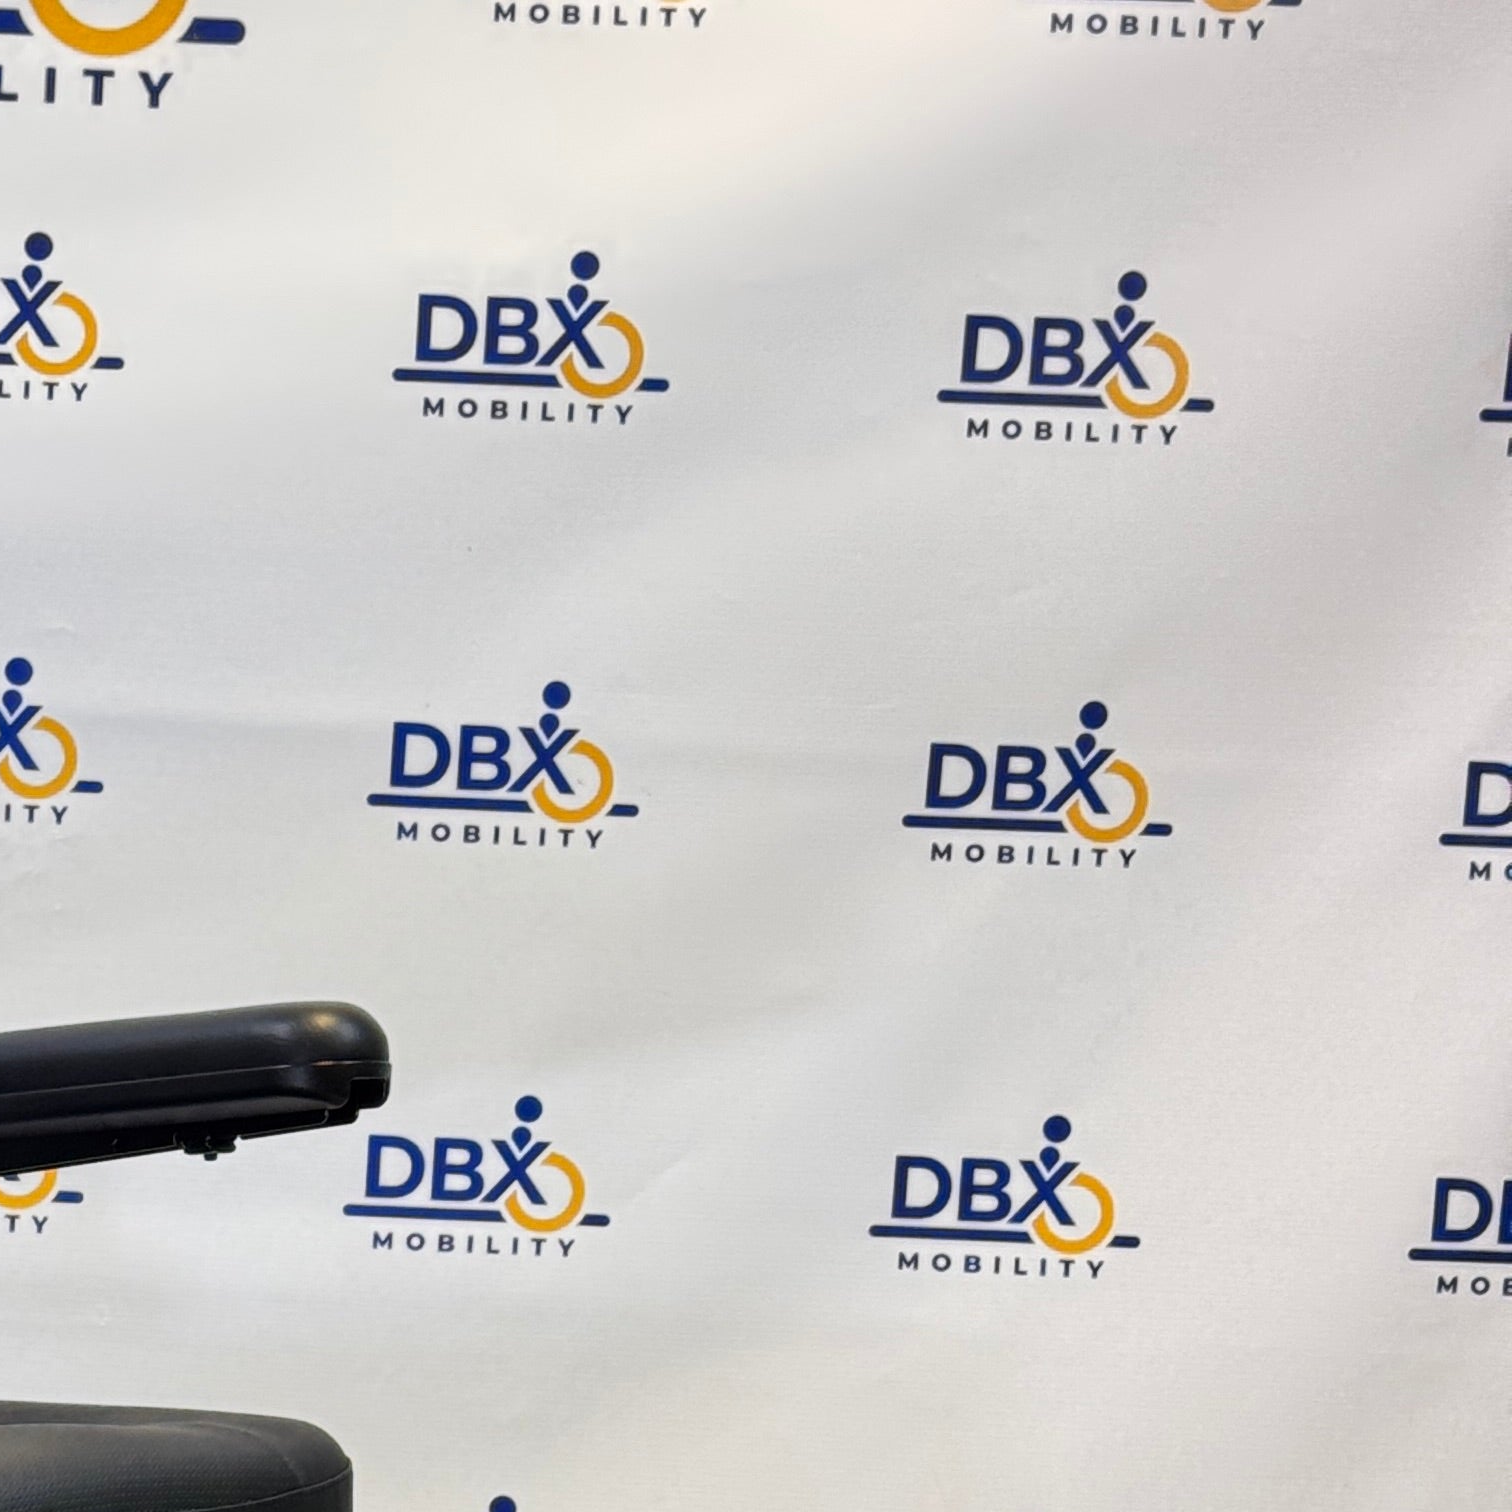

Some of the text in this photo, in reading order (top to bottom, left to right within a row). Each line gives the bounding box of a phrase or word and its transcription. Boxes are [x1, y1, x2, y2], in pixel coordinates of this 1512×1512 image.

[494, 3, 706, 27] MOBILITY
[1051, 13, 1264, 40] MOBILITY
[415, 294, 609, 369] DBX
[960, 314, 1155, 389] DBX
[423, 397, 632, 425] MOBILITY
[967, 419, 1176, 445] MOBILITY
[390, 722, 580, 795] DBX
[925, 742, 1115, 814] DBX
[397, 822, 602, 848] MOBILITY
[931, 843, 1136, 868] MOBILITY
[365, 1134, 551, 1205] DBX
[891, 1155, 1080, 1226] DBX
[373, 1232, 574, 1257] MOBILITY
[898, 1252, 1103, 1278] MOBILITY
